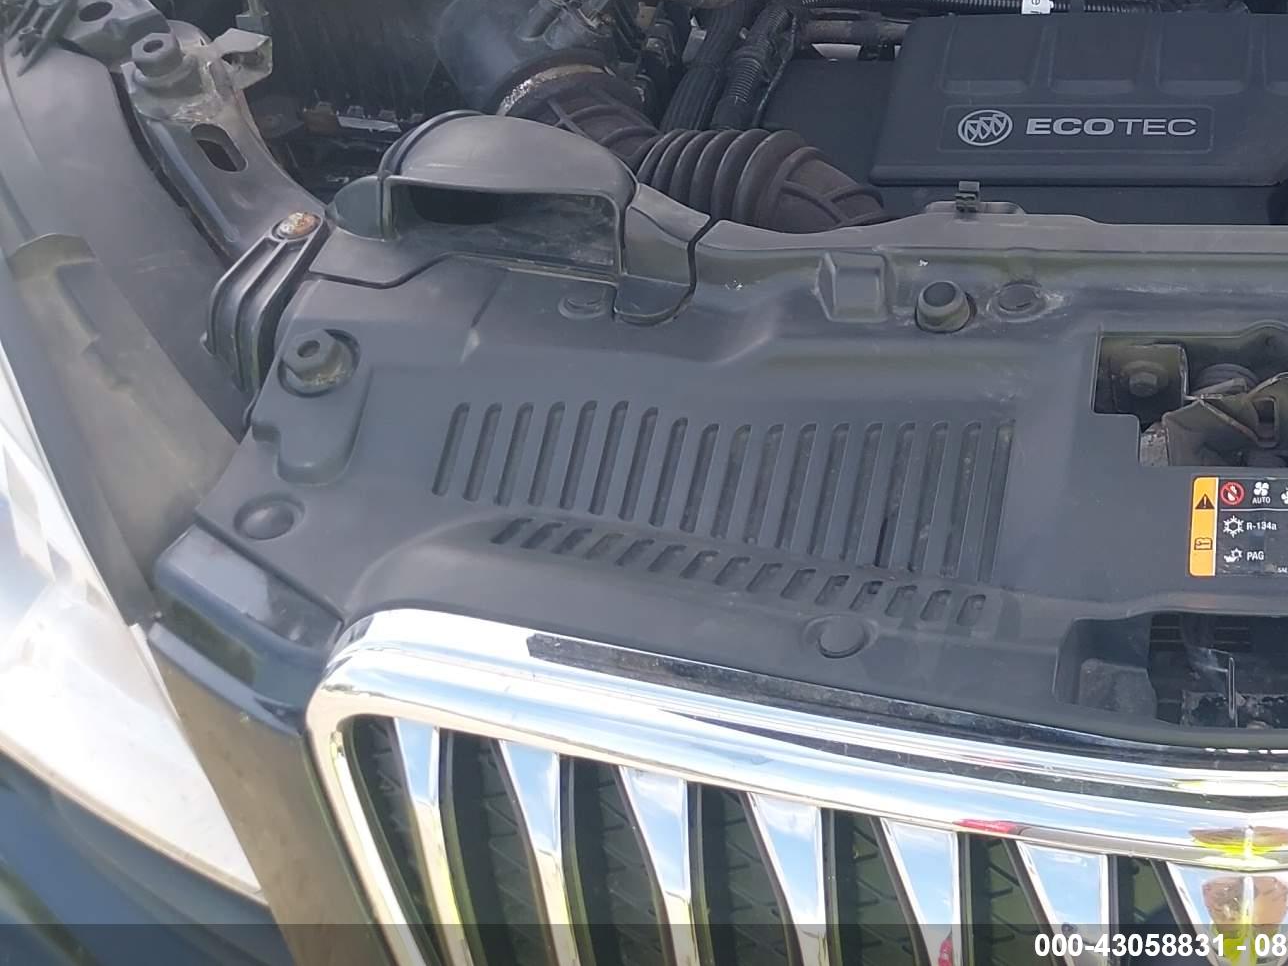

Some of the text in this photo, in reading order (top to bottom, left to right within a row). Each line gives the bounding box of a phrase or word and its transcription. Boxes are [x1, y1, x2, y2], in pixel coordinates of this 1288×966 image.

[1026, 118, 1197, 136] ECOTEC
[1252, 496, 1271, 504] AUTO
[1246, 521, 1277, 531] R-134a
[1246, 551, 1264, 560] PAG
